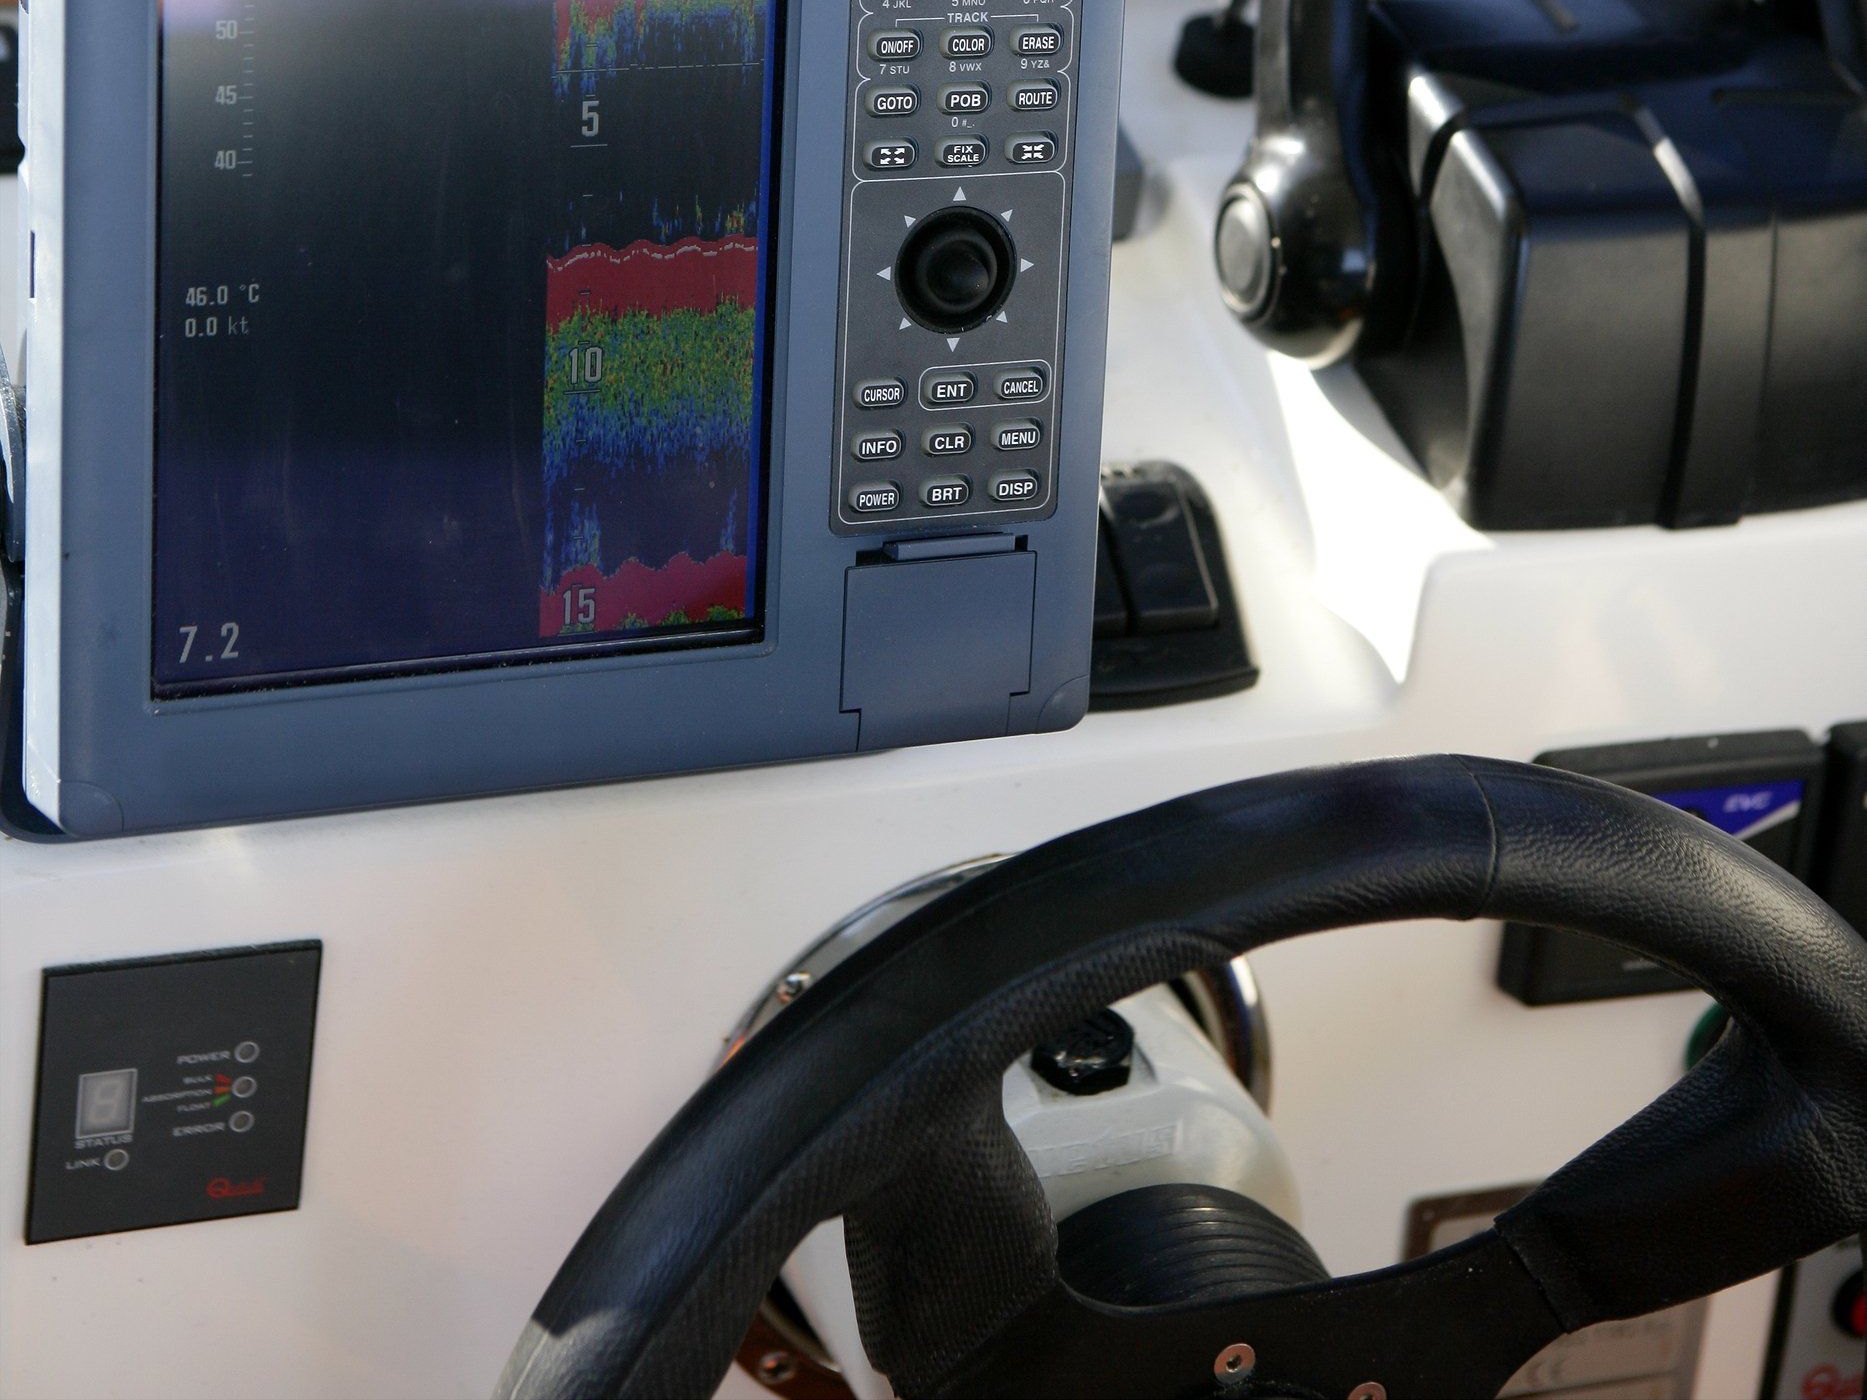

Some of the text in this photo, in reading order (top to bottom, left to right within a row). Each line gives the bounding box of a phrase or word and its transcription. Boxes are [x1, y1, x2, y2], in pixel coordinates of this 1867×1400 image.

[893, 0, 912, 9] JKL
[947, 11, 989, 23] TRACK
[215, 20, 238, 39] 50
[881, 39, 914, 54] ON/OFF
[952, 38, 985, 52] COLOR
[1022, 36, 1055, 50] ERASE
[879, 64, 910, 75] 7 STU
[949, 61, 982, 72] 8 VWX
[1020, 58, 1050, 70] 9 YZ&
[215, 85, 237, 105] 45
[950, 94, 981, 108] POB
[1018, 91, 1053, 106] ROUTE
[877, 96, 913, 110] GOTO
[581, 100, 600, 138] 5
[951, 117, 959, 128] 0
[953, 145, 974, 154] FIX
[214, 150, 237, 169] 40
[947, 153, 980, 163] SCALE
[185, 283, 260, 306] 46.0 °C
[185, 316, 249, 337] 0.0 kt
[568, 346, 602, 385] 10
[864, 387, 900, 402] CURSOR
[936, 383, 967, 398] ENT
[1003, 380, 1039, 394] CANCEL
[934, 435, 965, 450] CLR
[1001, 431, 1036, 446] MENU
[861, 440, 897, 455] INFO
[932, 486, 963, 502] BRT
[999, 482, 1033, 496] DISP
[859, 492, 895, 507] POWER
[562, 587, 596, 625] 15
[179, 622, 240, 664] 7.2
[176, 1050, 231, 1065] POWER
[172, 1121, 226, 1138] ERROR
[74, 1133, 134, 1150] STATUS
[65, 1157, 101, 1170] LINK
